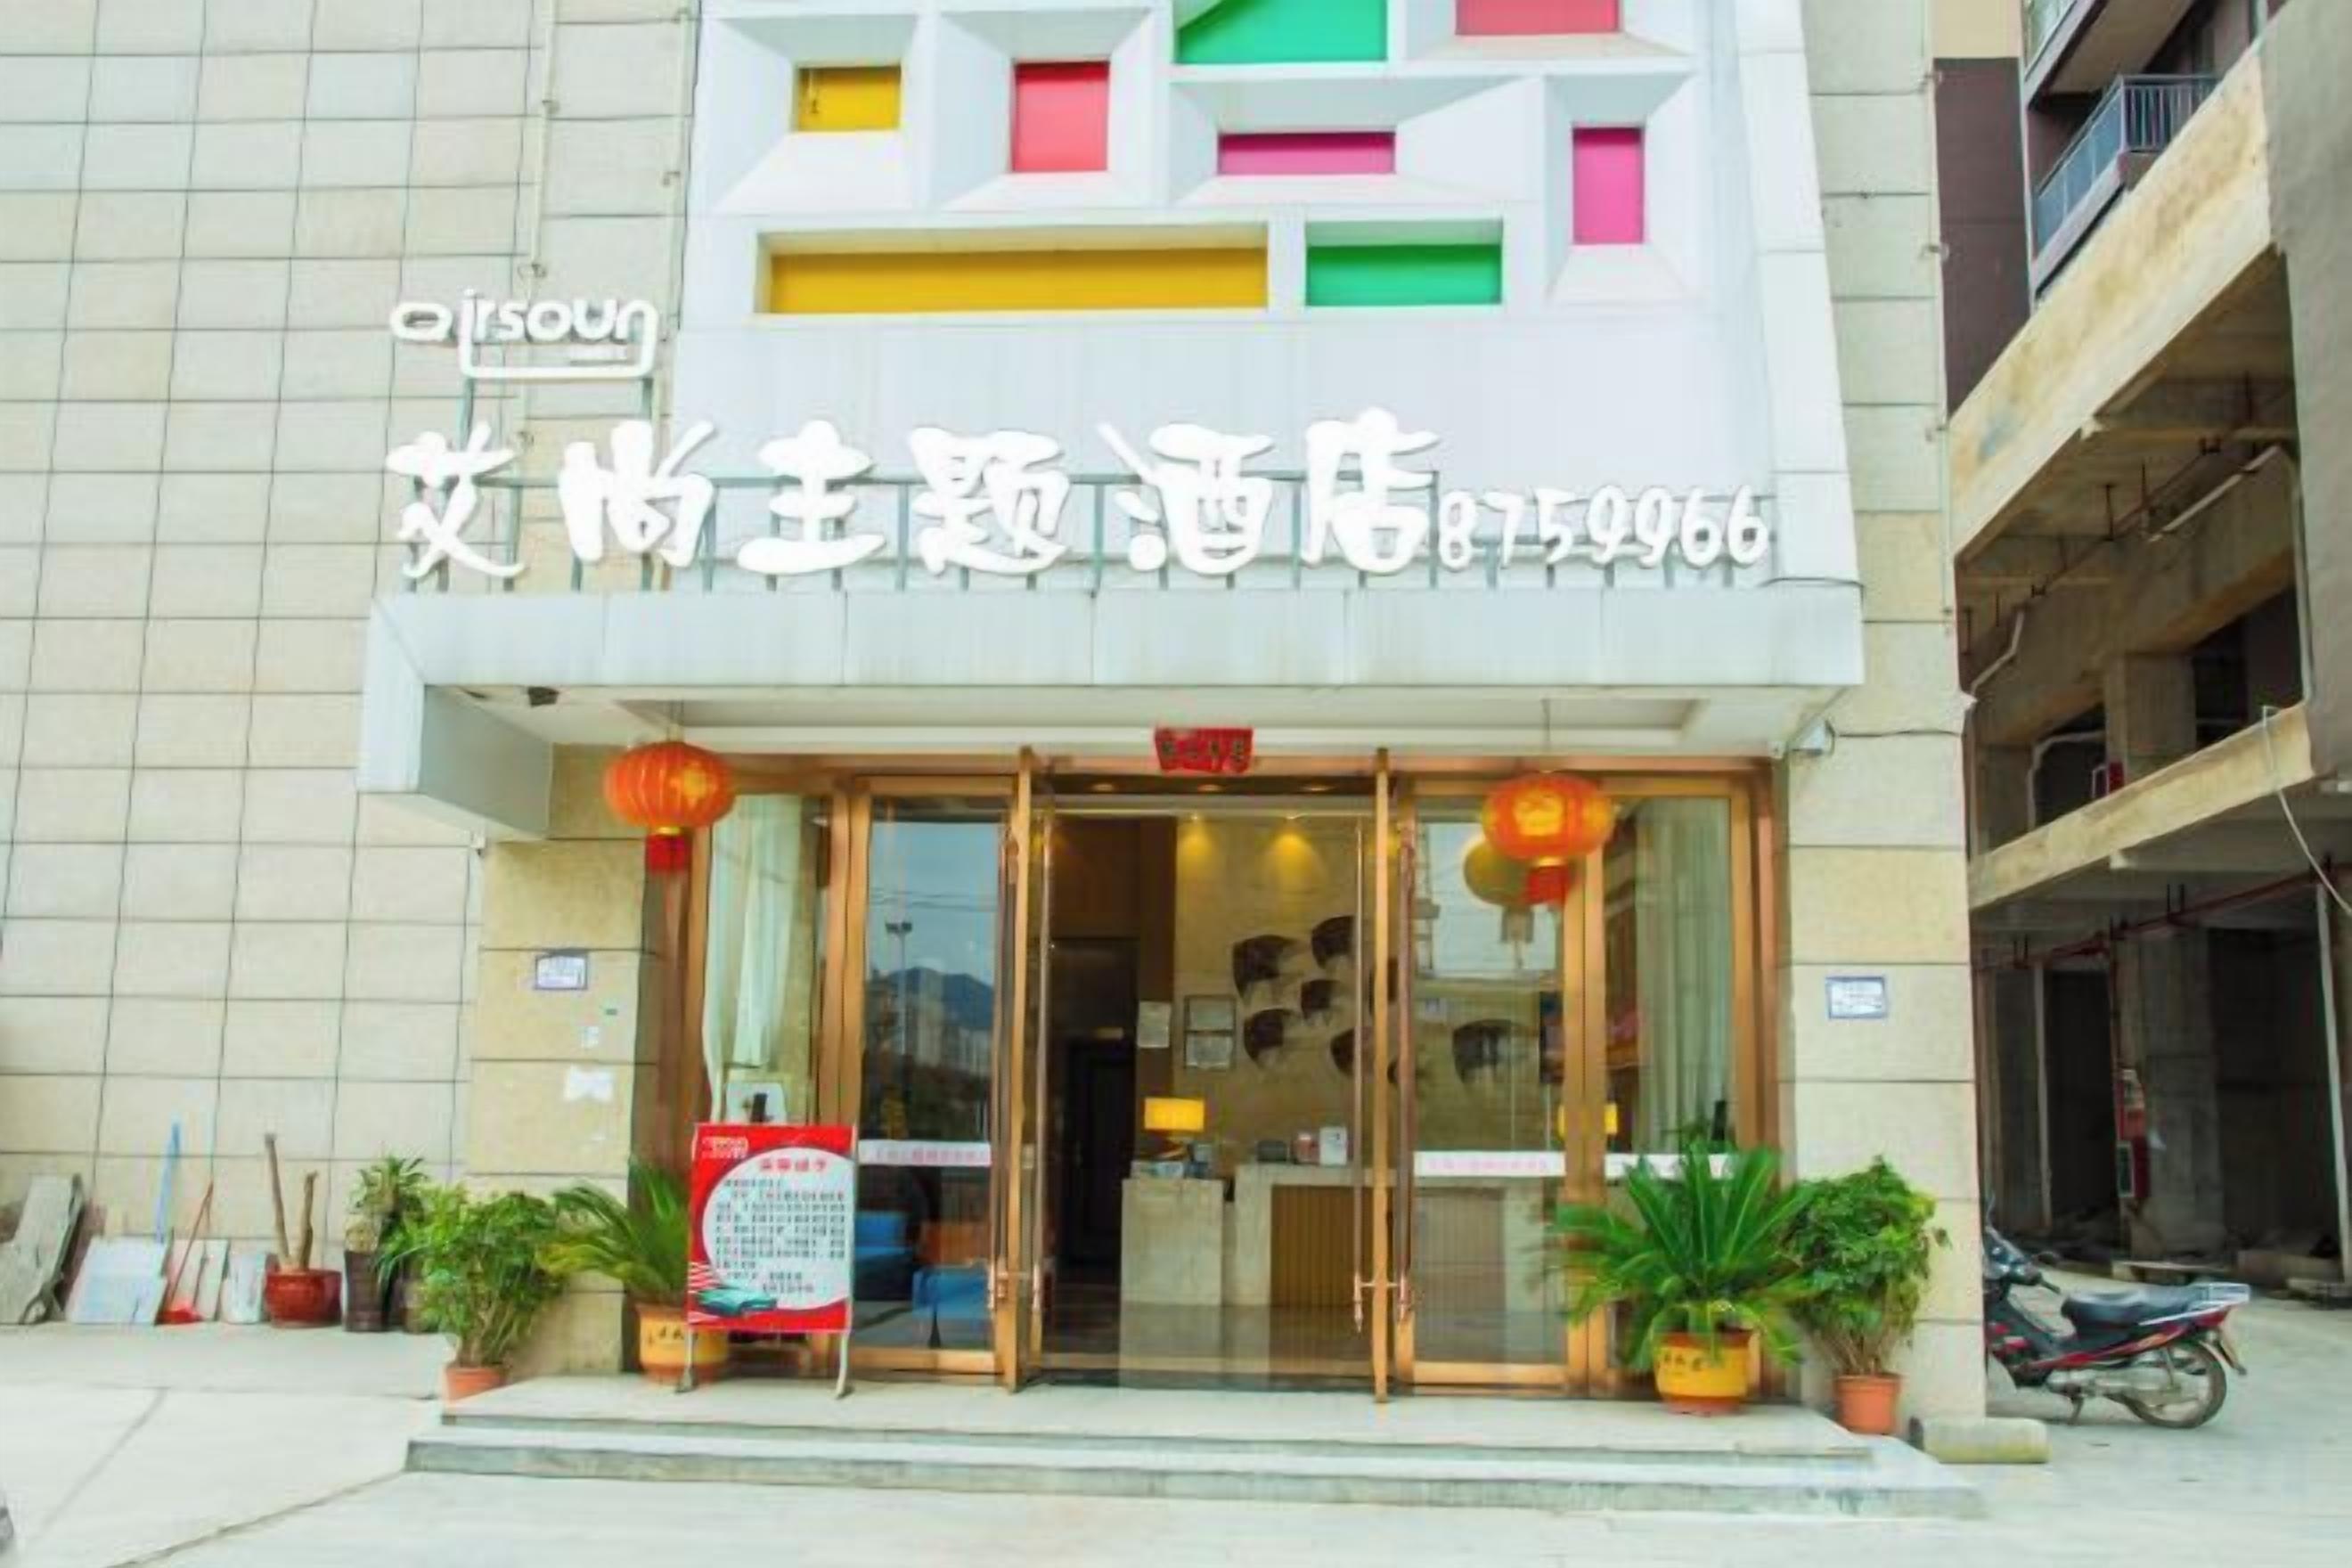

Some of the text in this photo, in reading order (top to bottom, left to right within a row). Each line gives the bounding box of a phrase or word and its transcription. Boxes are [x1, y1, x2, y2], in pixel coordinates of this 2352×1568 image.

[385, 406, 1771, 577] 艾尚主题酒店 8759966
